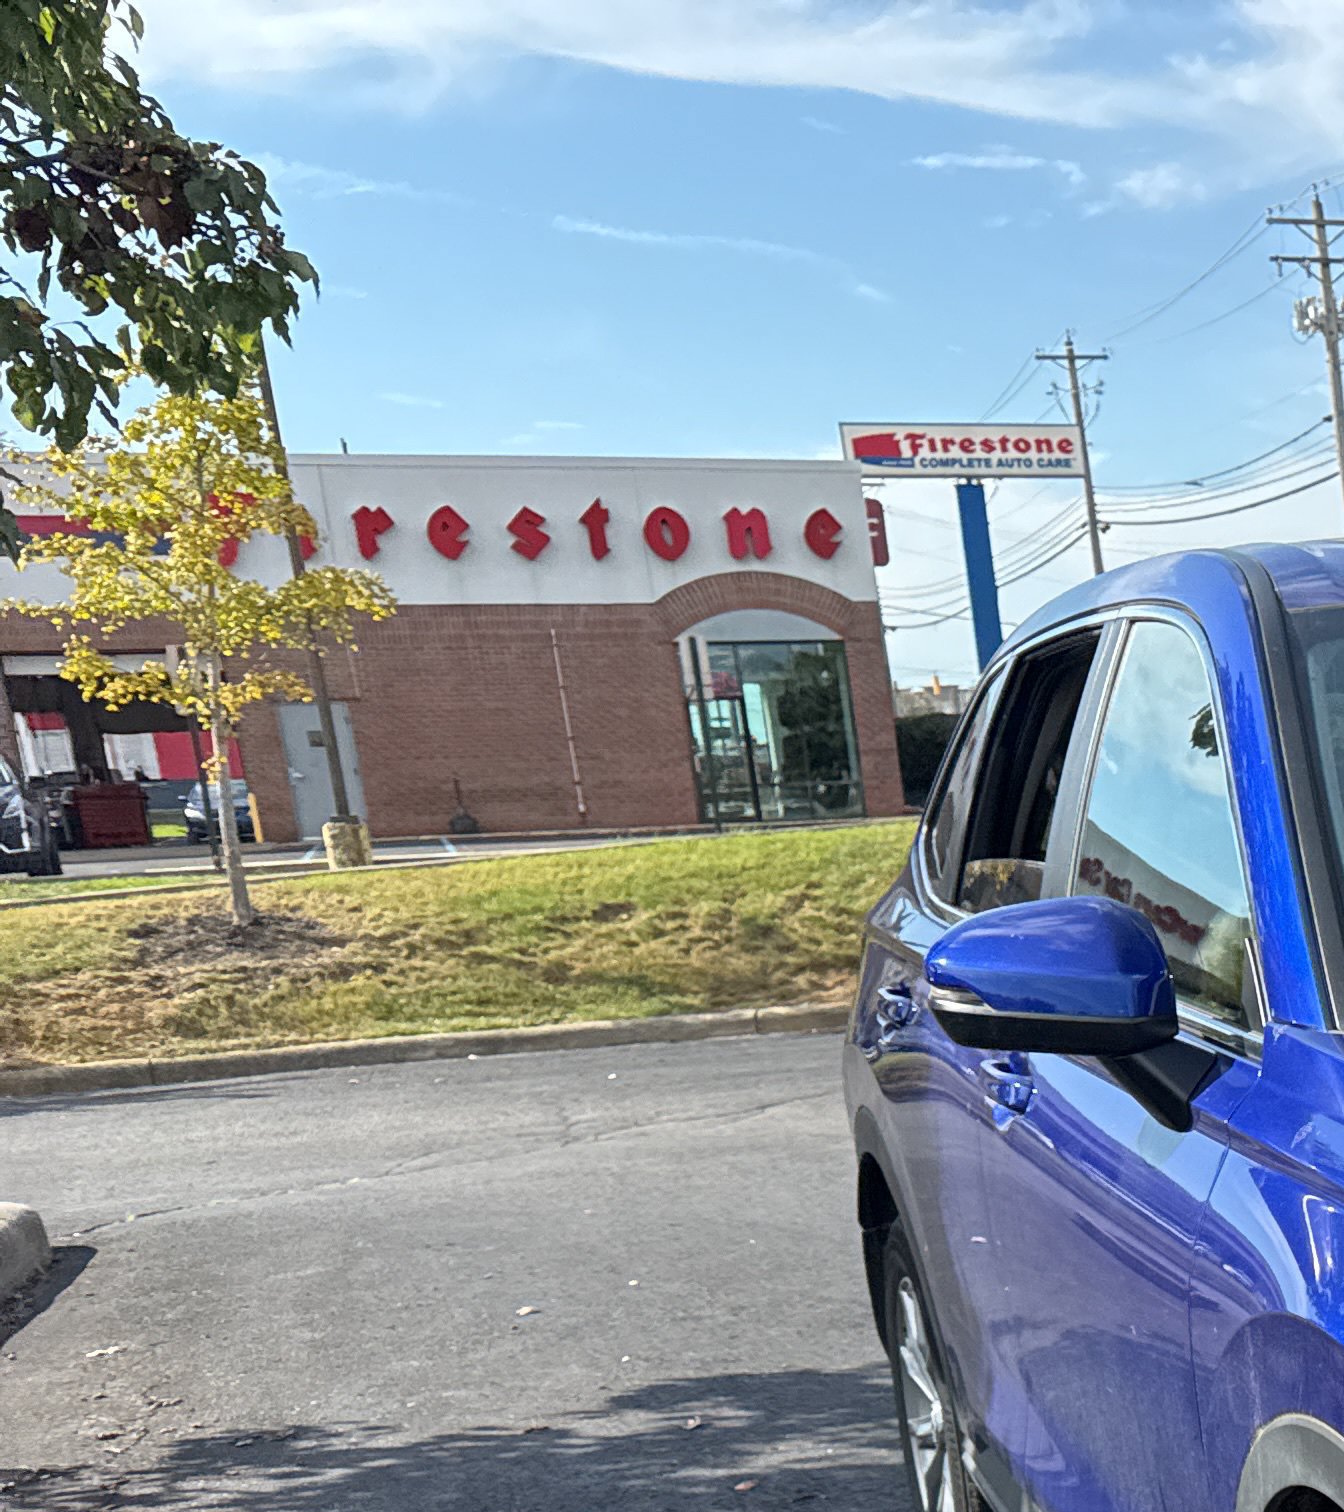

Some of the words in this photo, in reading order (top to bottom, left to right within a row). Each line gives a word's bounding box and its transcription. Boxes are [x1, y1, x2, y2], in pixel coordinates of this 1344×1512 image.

[903, 432, 1074, 457] Firestone
[919, 457, 992, 469] COMPLETE
[995, 457, 1033, 469] AUTO
[1037, 457, 1072, 469] CARE
